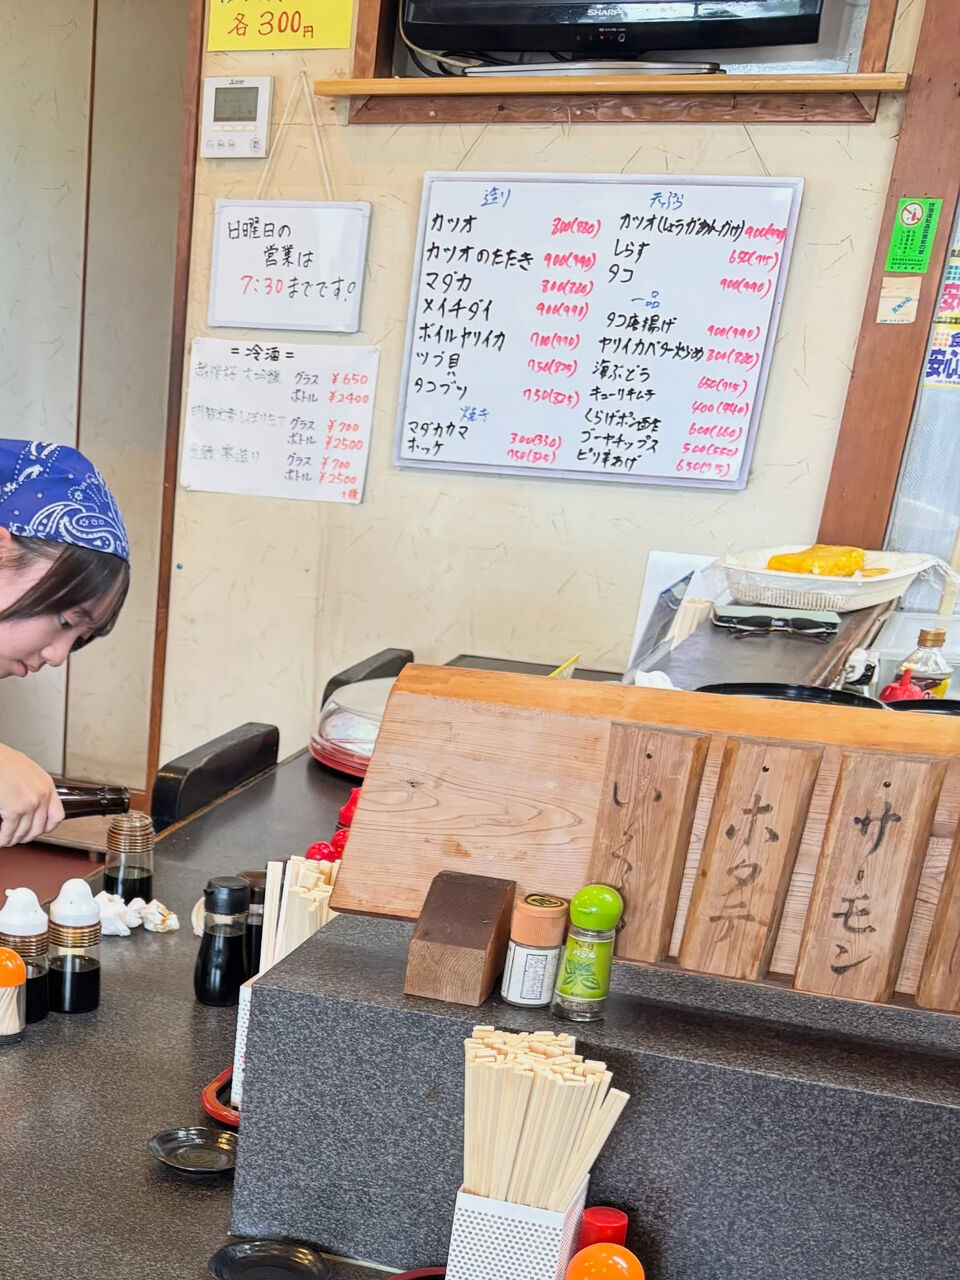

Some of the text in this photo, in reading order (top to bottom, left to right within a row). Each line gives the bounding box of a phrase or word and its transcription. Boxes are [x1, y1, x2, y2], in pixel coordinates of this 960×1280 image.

[228, 217, 291, 240] 日曜日の
[431, 213, 478, 233] カツオ
[264, 243, 314, 268] 営業は
[426, 242, 534, 271] カツオのたたき
[614, 238, 650, 263] しらす
[426, 271, 472, 293] マダカ
[608, 264, 634, 283] タコ
[422, 297, 493, 322] メイチダイ
[607, 312, 677, 334] タコ唐揚げ
[418, 322, 506, 352] ボイルヤリイカ
[294, 370, 319, 386] グラス
[592, 358, 651, 383] 海ぶどう
[290, 389, 319, 403] ボトル
[414, 377, 468, 401] タコブツ
[290, 416, 316, 431] グラス
[408, 421, 469, 440] マダカカマ
[288, 432, 317, 445] ボトル
[407, 437, 445, 456] ホッケ
[581, 427, 659, 453] ゴーヤチップス
[287, 452, 312, 467] グラス
[284, 468, 313, 482] ボトル
[709, 794, 779, 944] ホタテ
[831, 801, 902, 977] サーモン
